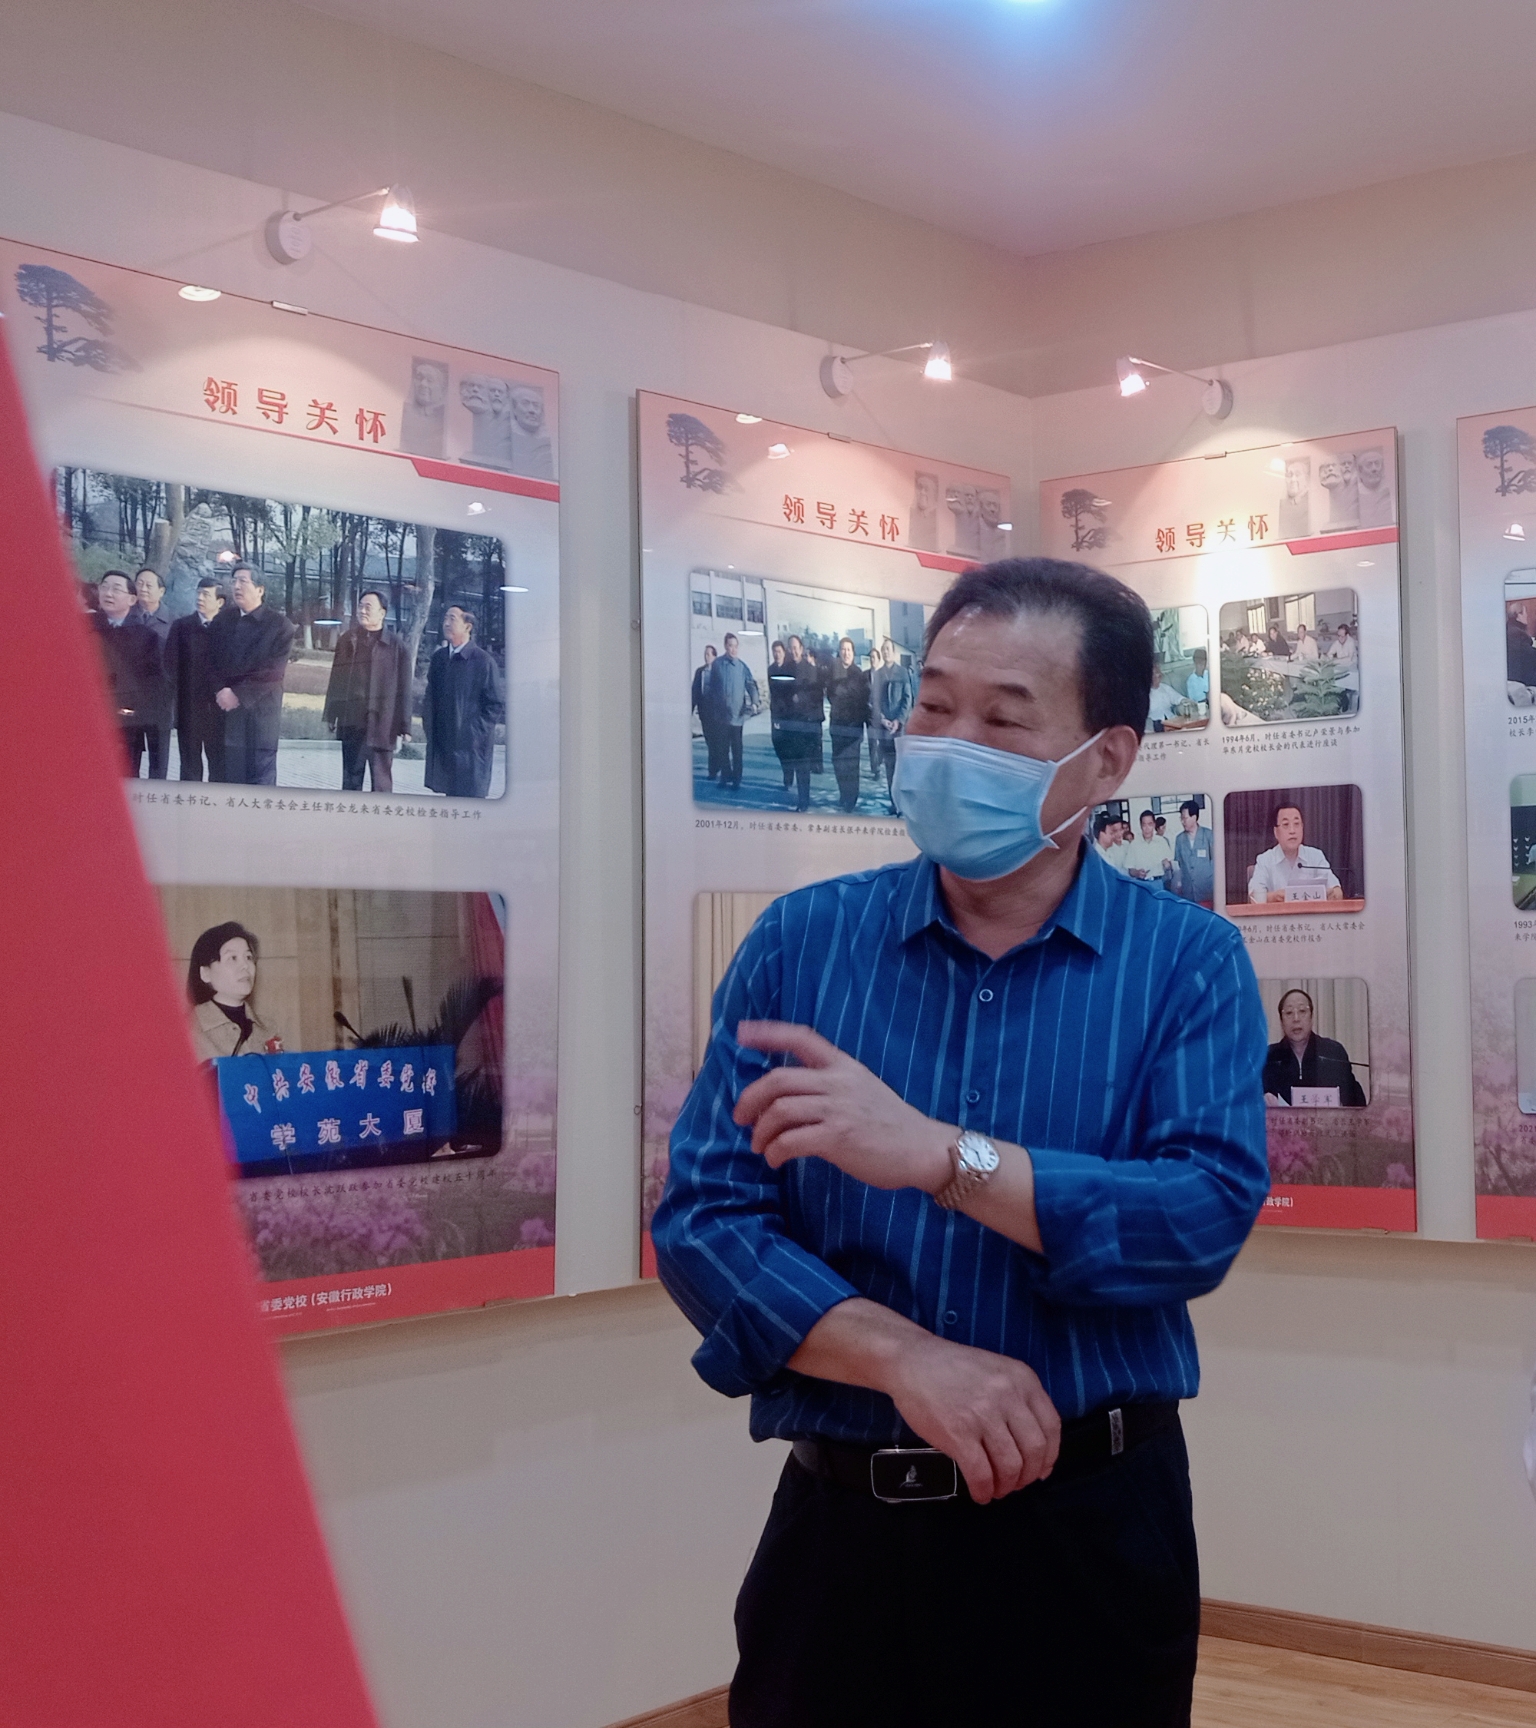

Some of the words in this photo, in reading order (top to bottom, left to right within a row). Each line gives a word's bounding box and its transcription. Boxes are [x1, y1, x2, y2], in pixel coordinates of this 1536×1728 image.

[203, 377, 387, 444] 领导关怀
[782, 494, 900, 542] 领导关怀
[1155, 514, 1269, 553] 领导关怀
[1291, 891, 1321, 901] 王金山
[1239, 921, 1365, 934] 年6月，时任省委书记、省人大常委会
[243, 1059, 437, 1113] 中共安徽省委党校
[270, 1109, 424, 1151] 学苑大厦
